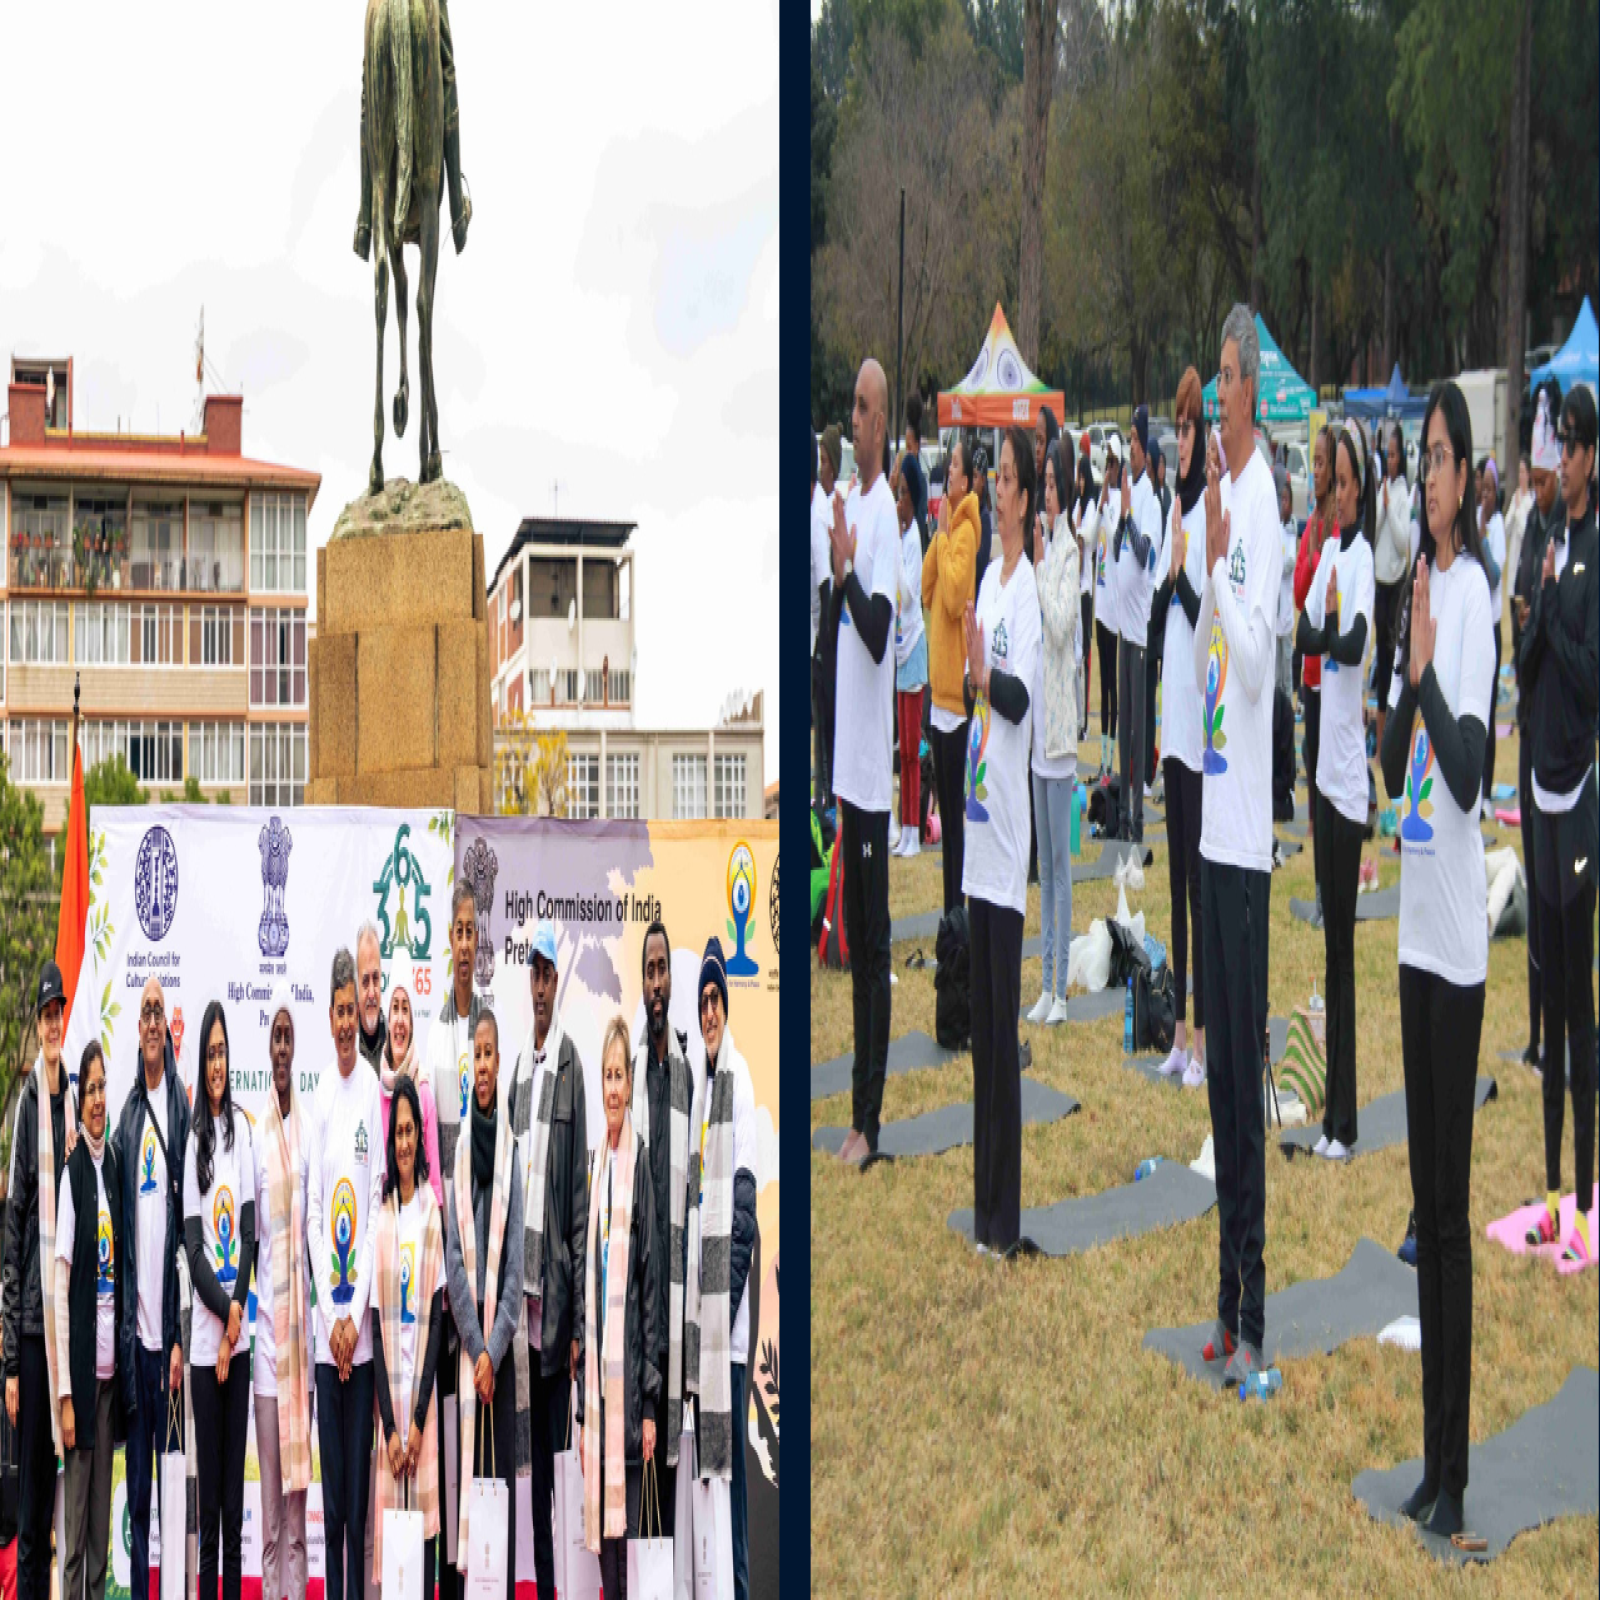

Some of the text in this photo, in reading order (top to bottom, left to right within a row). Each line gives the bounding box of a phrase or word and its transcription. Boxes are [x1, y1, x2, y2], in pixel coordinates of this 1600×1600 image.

[504, 889, 662, 926] High Commission of India
[126, 951, 180, 967] Indian Council for
[504, 935, 532, 965] Pret
[126, 971, 180, 988] Cultur lations
[412, 967, 432, 995] 65
[227, 981, 244, 1004] High
[245, 981, 272, 1001] Commi
[294, 984, 315, 1003] India,
[299, 1071, 320, 1093] DAY
